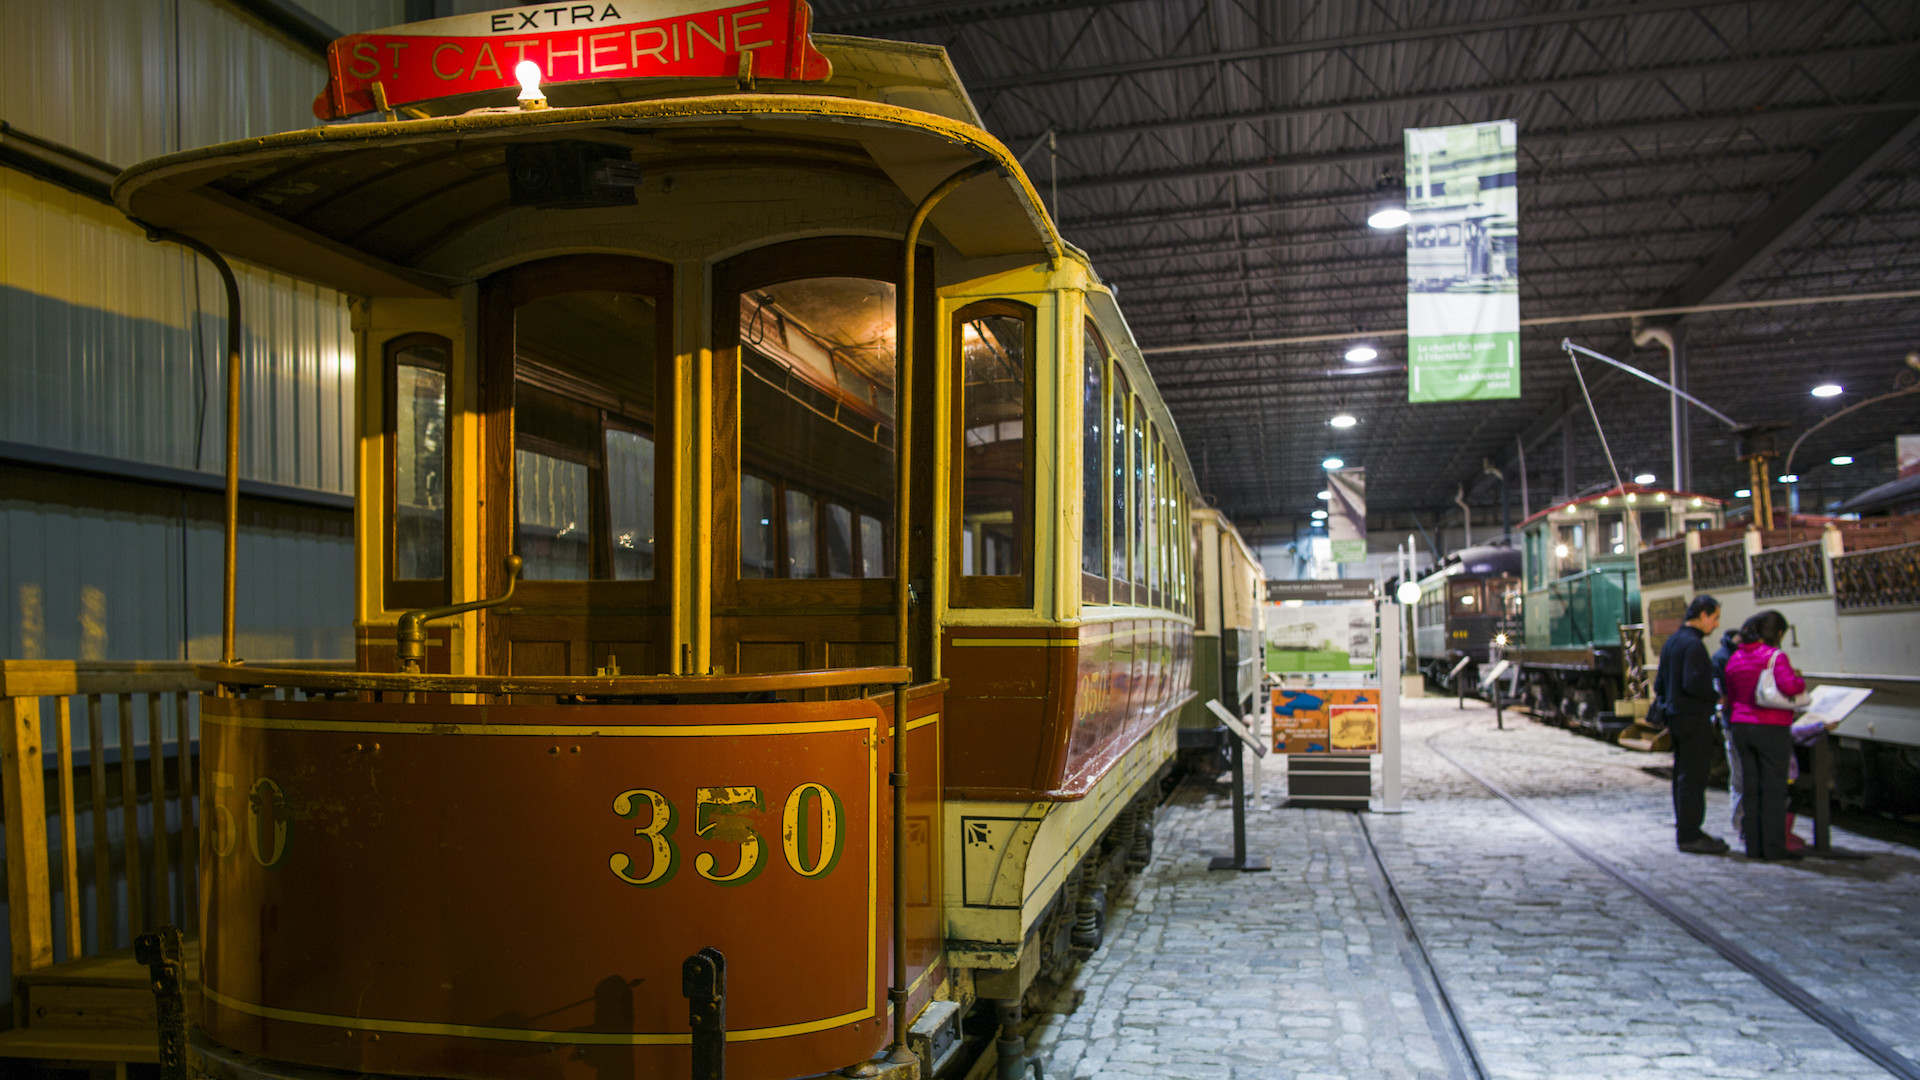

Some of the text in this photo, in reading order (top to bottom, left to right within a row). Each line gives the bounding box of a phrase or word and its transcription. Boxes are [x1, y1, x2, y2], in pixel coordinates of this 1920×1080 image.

[431, 6, 774, 81] CATHERINE
[491, 3, 622, 32] EXTRA
[1079, 669, 1107, 721] 350
[200, 767, 288, 867] 50
[608, 782, 838, 885] 350
